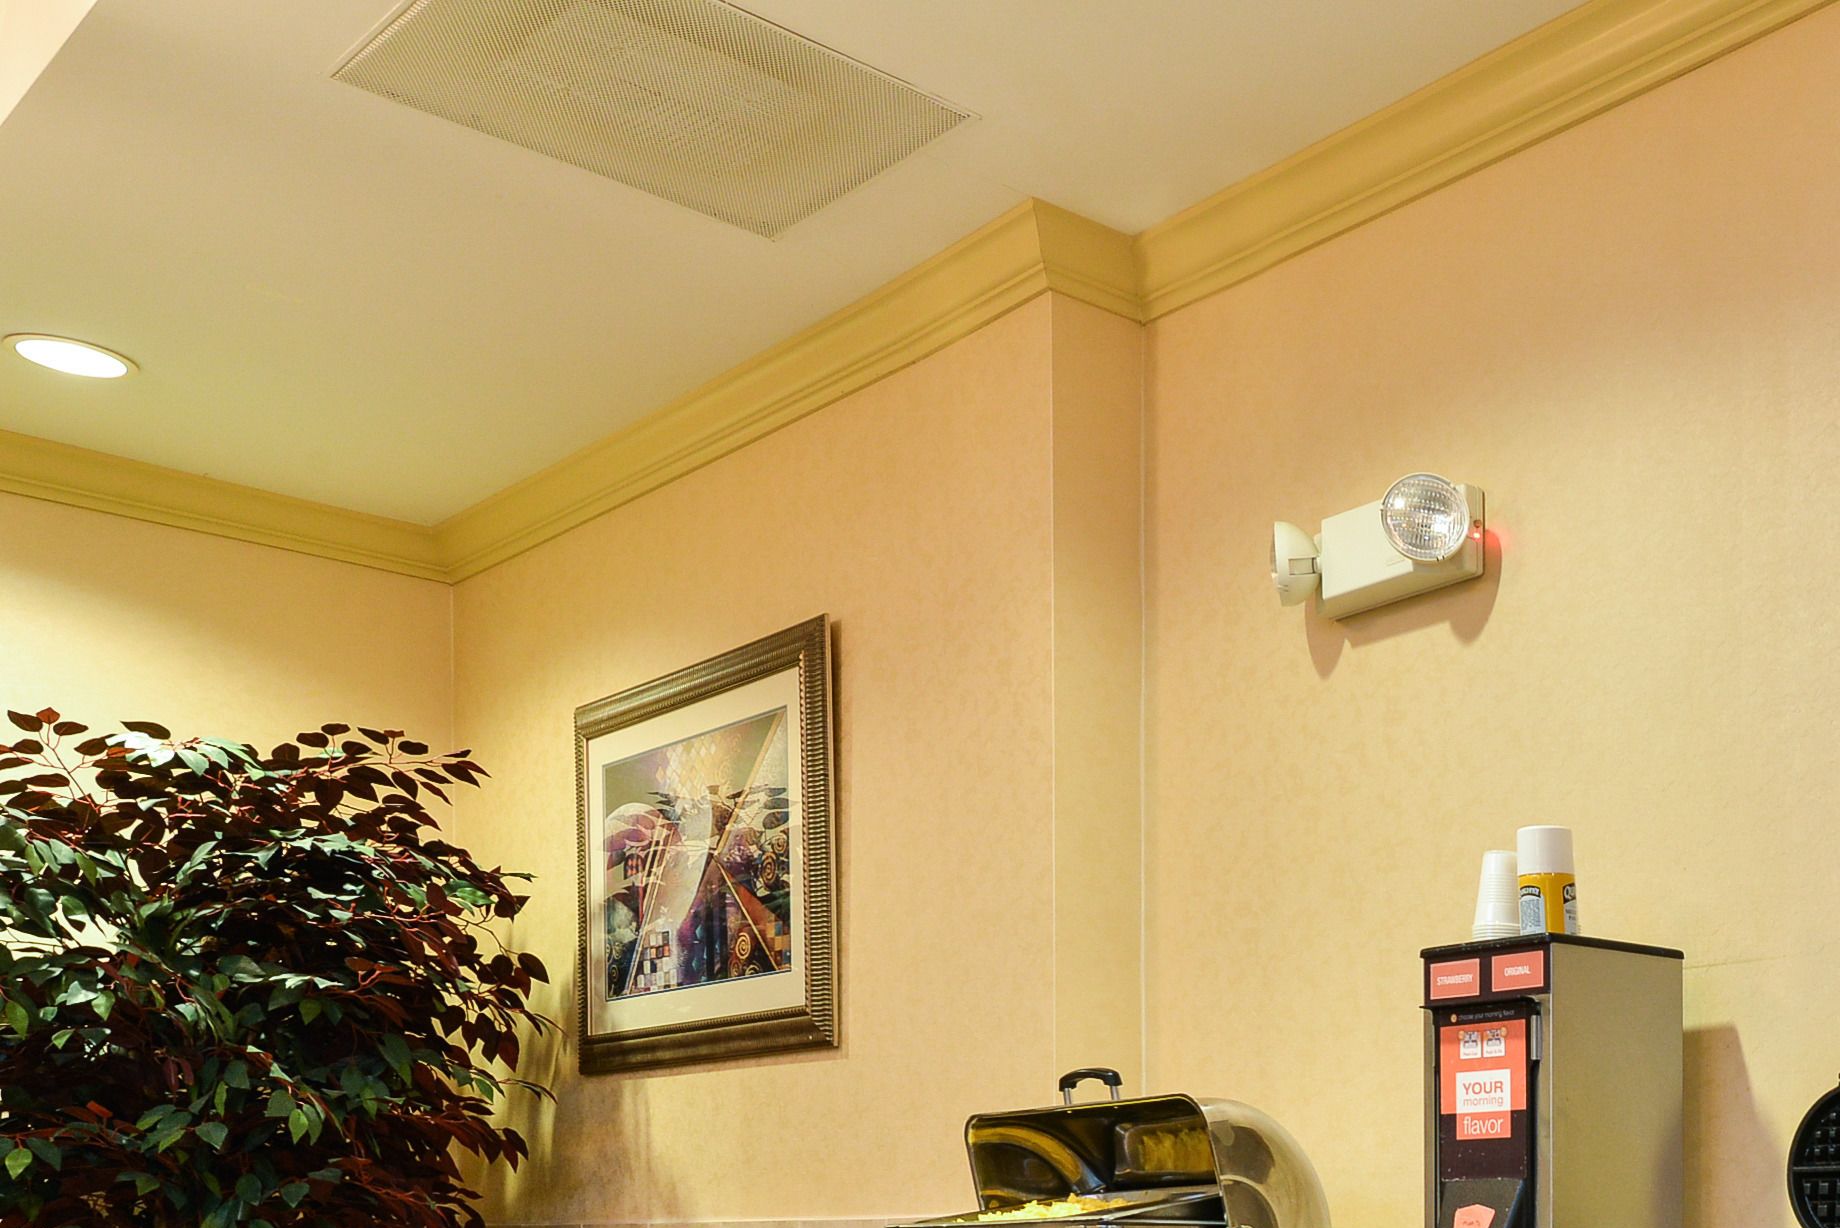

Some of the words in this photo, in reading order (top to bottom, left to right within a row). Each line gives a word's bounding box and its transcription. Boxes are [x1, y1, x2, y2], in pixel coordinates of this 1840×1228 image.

[1504, 965, 1532, 976] ORIGINAL
[1436, 974, 1473, 986] STRAWBERRY
[1462, 1080, 1504, 1095] YOUR
[1463, 1096, 1504, 1107] morning
[1463, 1116, 1504, 1135] flavor
